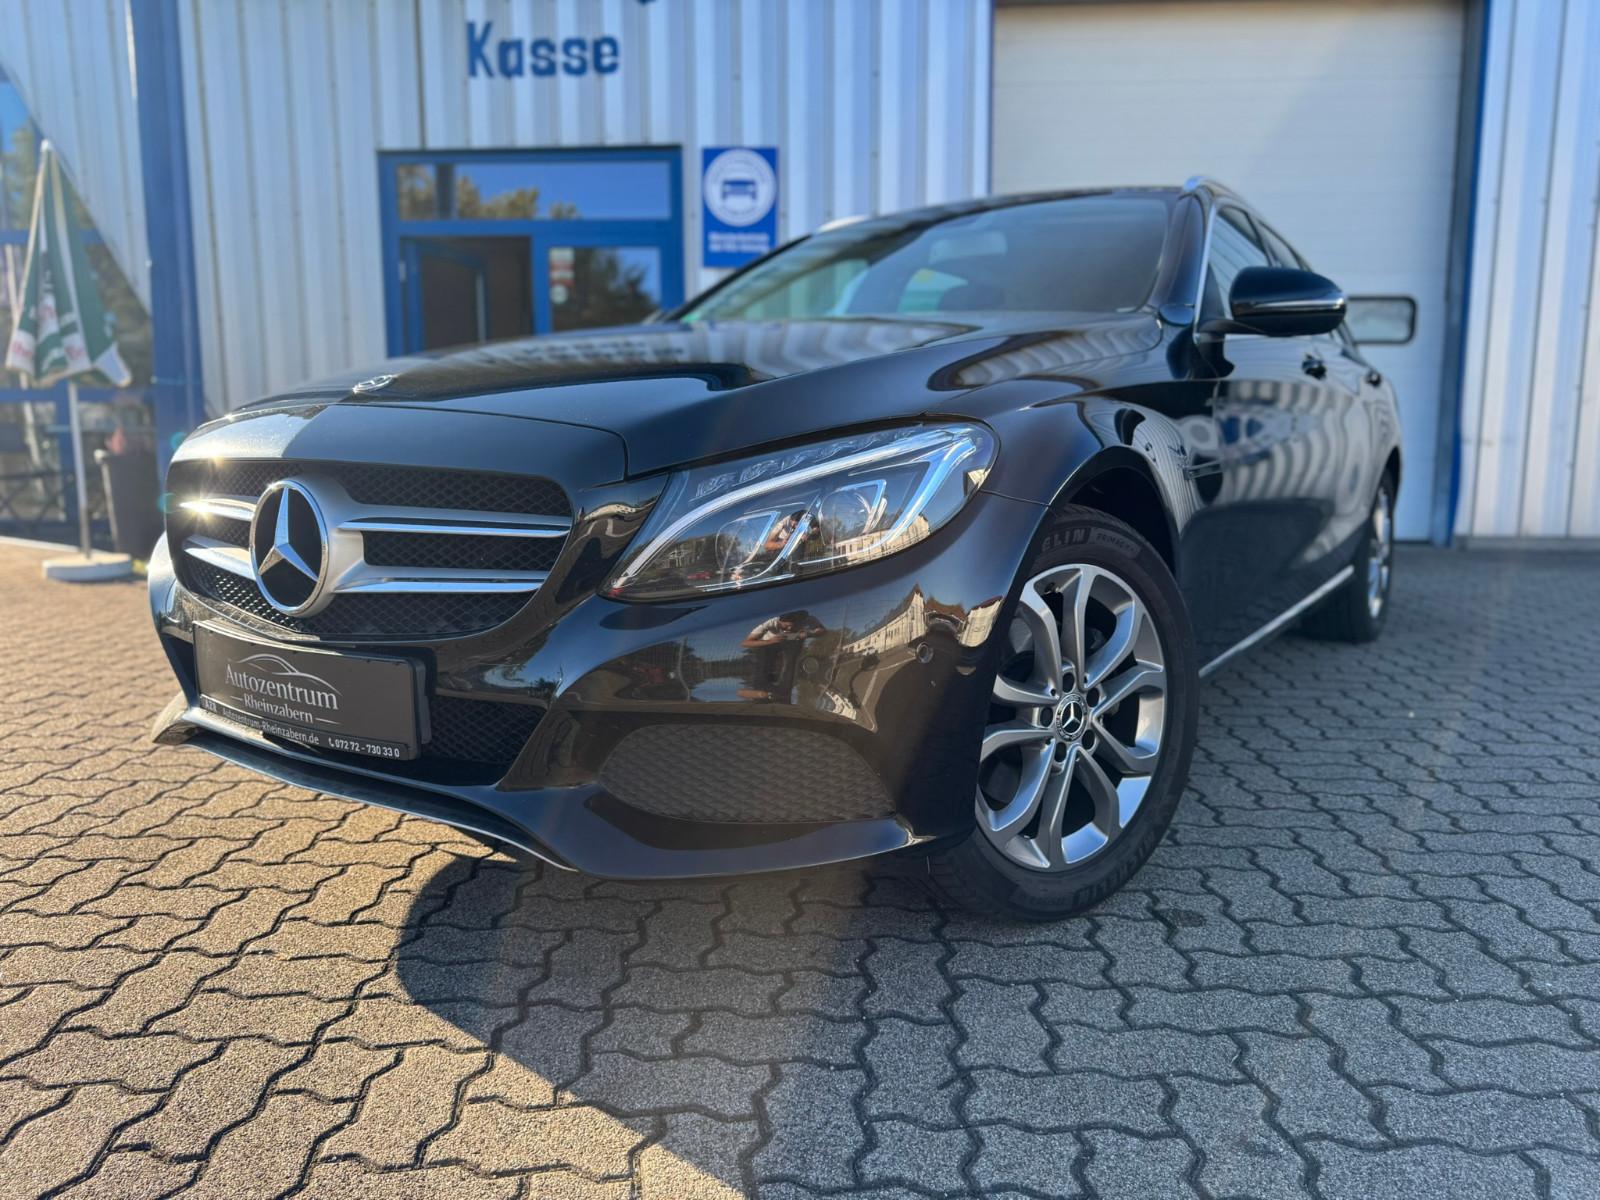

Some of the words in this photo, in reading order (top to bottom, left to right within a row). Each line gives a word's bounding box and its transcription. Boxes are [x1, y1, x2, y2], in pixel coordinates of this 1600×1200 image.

[466, 20, 619, 79] Kasse
[225, 663, 339, 710] Autozentrum
[244, 693, 314, 724] Rheinzabern
